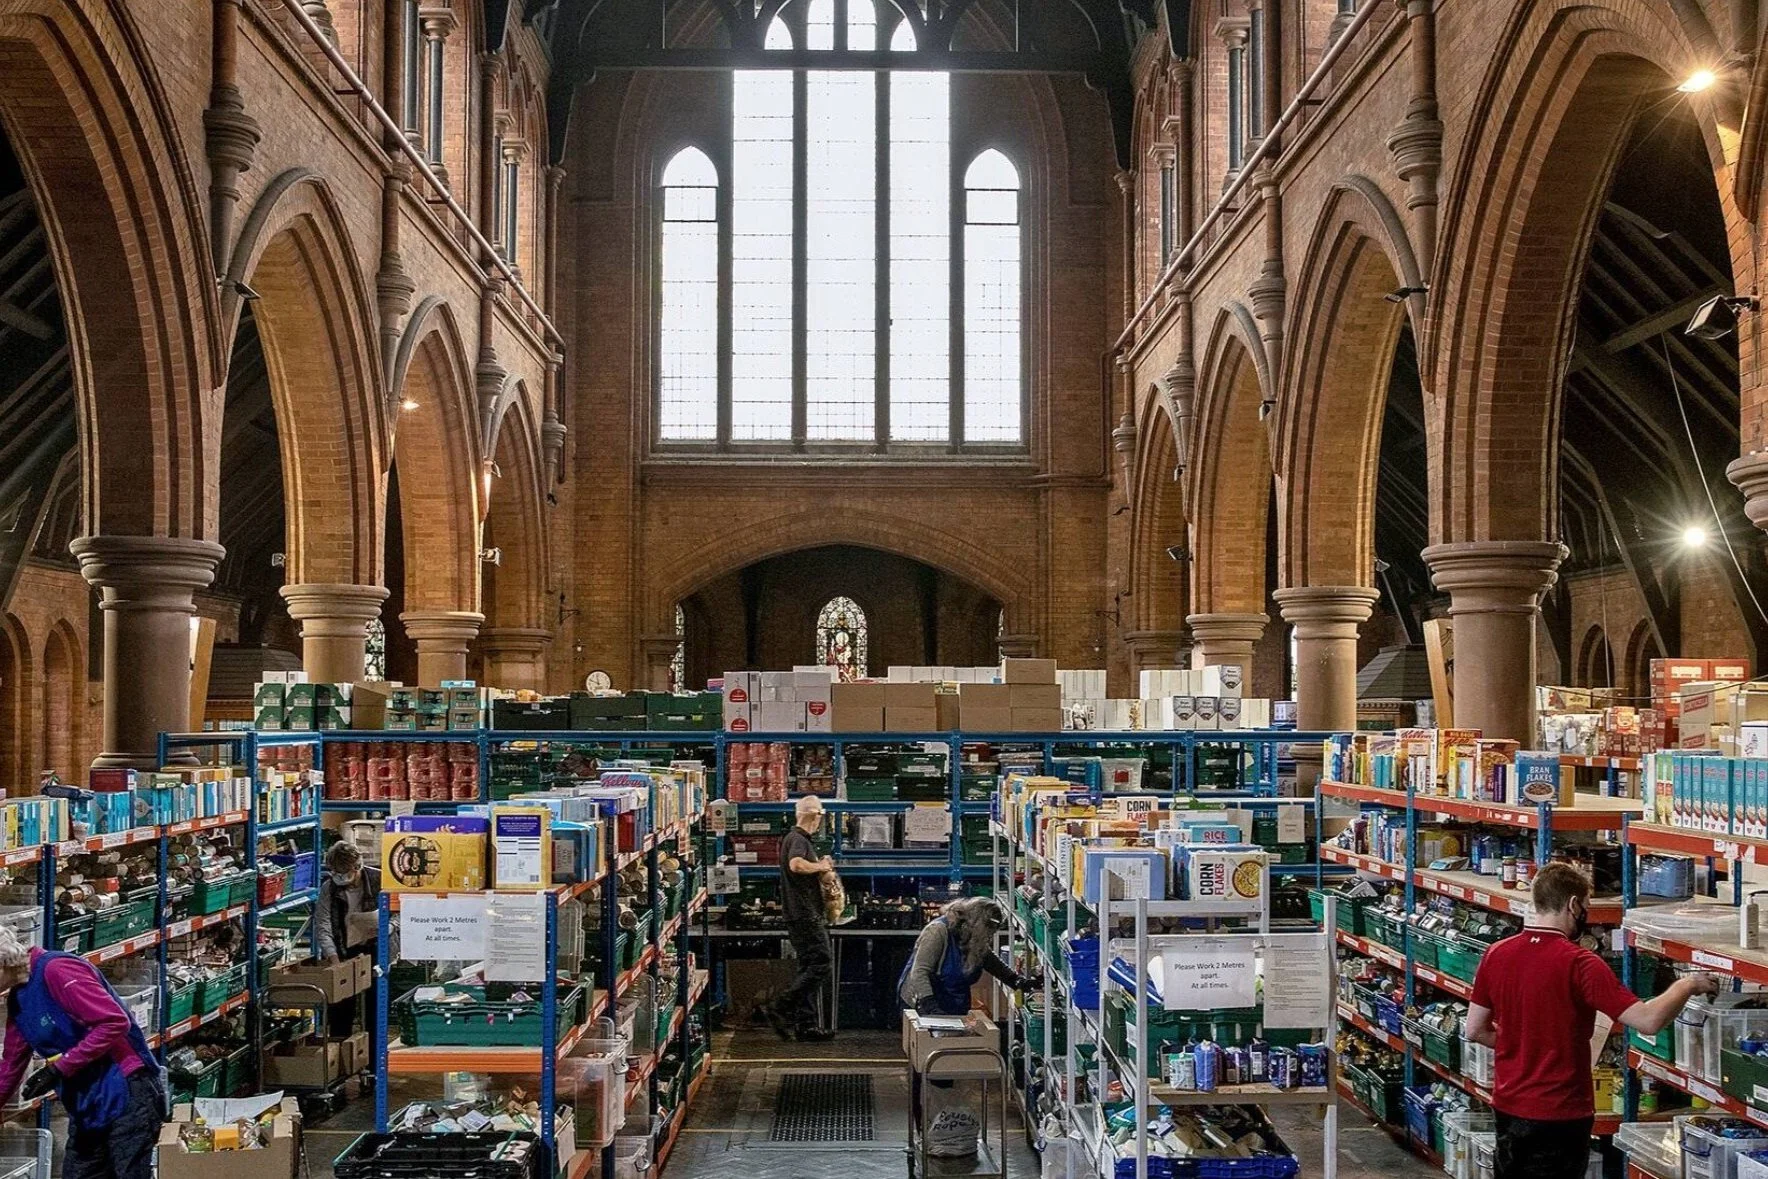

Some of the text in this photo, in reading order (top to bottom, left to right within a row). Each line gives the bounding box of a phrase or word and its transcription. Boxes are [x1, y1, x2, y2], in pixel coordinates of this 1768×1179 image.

[1529, 766, 1550, 774] BRAN
[1526, 774, 1553, 782] FLAKES
[1126, 800, 1152, 812] CORN
[1126, 812, 1148, 822] FLAKE
[1203, 831, 1226, 840] RICE
[1199, 863, 1214, 896] CORN
[1214, 863, 1225, 896] FLAKES
[410, 916, 478, 924] Please Work 2 Metres
[1174, 963, 1196, 971] Please
[1197, 962, 1215, 970] Work
